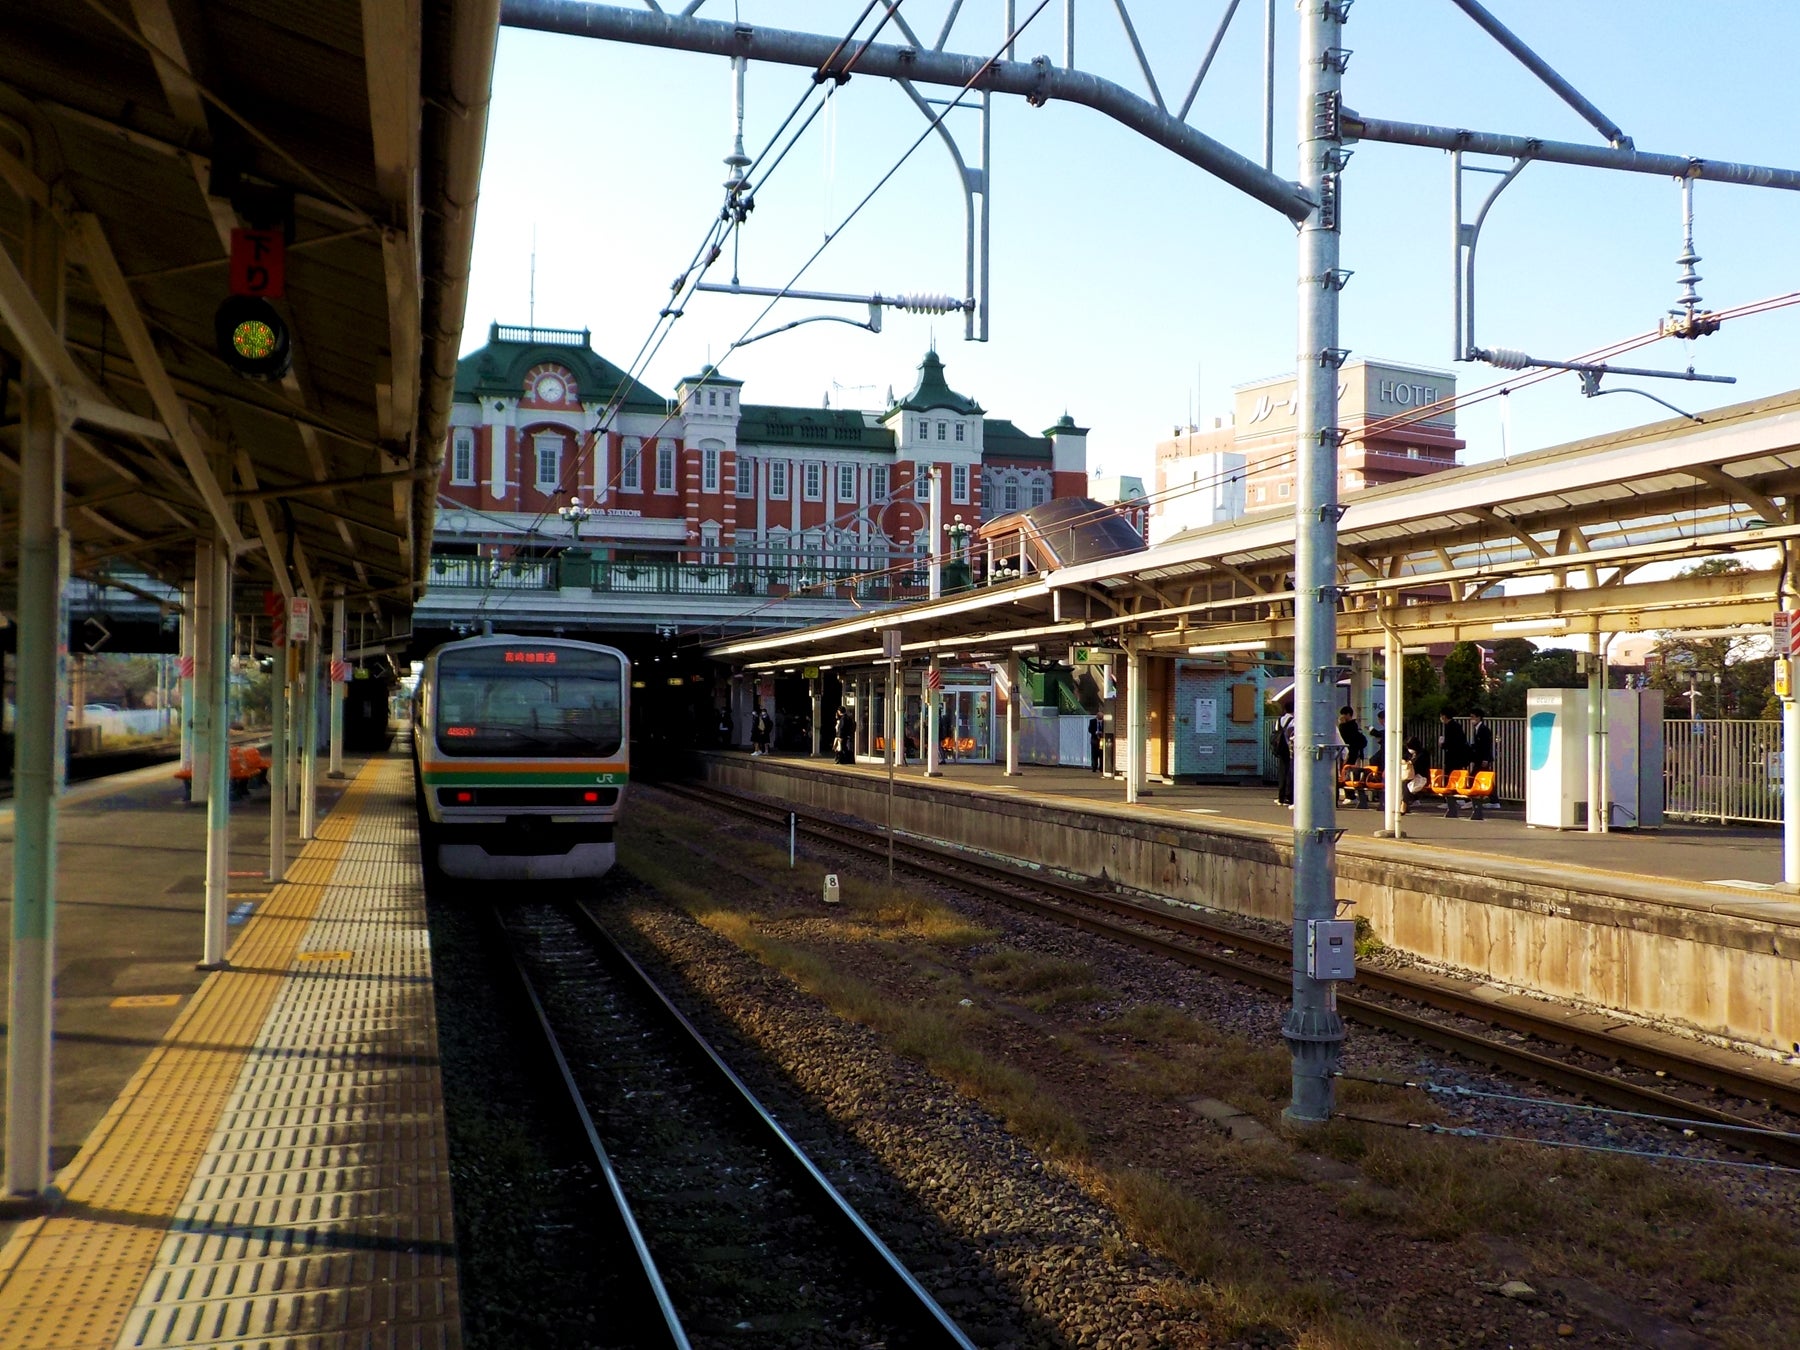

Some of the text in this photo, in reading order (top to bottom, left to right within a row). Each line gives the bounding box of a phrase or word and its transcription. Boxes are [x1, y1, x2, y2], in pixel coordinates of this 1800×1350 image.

[244, 234, 272, 291] 下り
[1379, 379, 1443, 410] HOTEL
[607, 508, 641, 517] STATION
[596, 773, 614, 784] JR
[829, 876, 837, 887] 8
